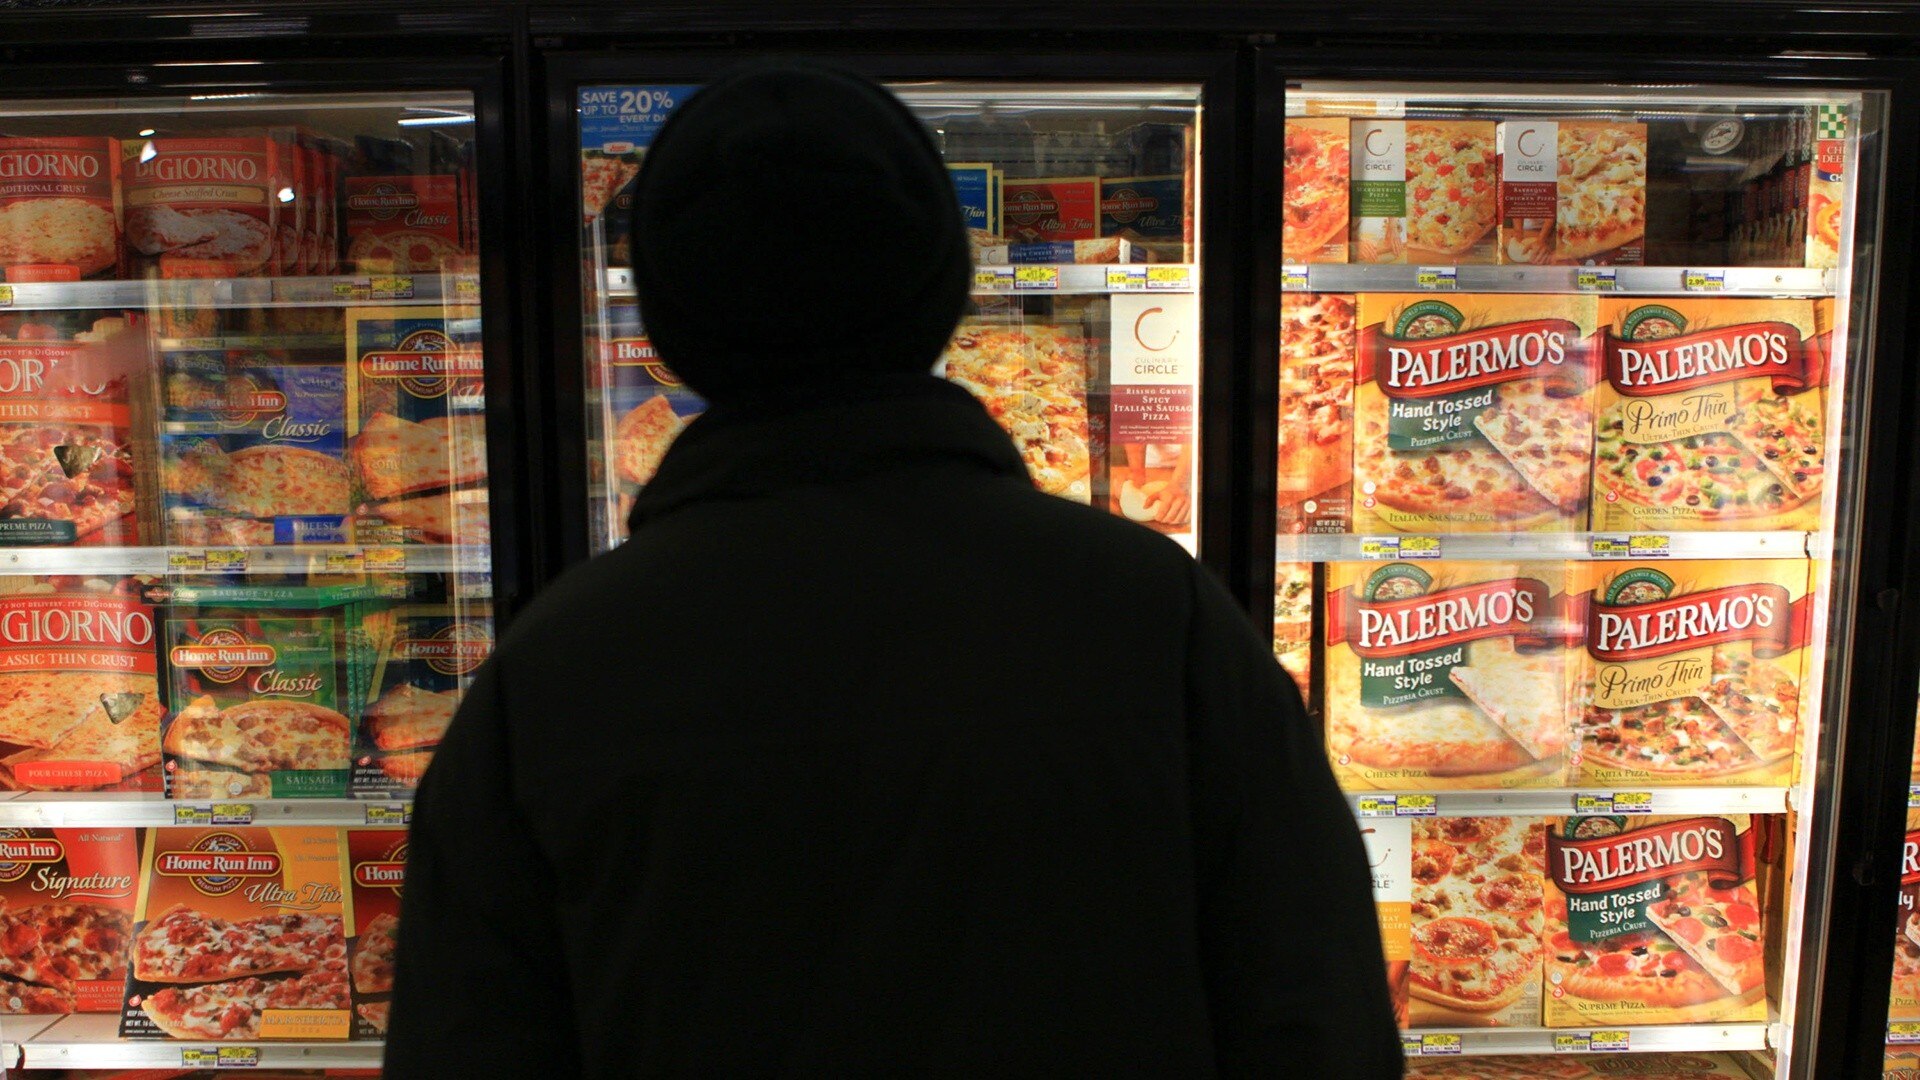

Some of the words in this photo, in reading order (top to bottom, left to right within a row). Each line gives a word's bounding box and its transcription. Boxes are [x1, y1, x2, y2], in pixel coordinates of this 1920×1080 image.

[582, 91, 618, 104] SAVE
[620, 90, 674, 114] 20%
[582, 105, 599, 116] UP
[600, 104, 618, 115] TO
[619, 114, 651, 123] EVERY
[653, 114, 668, 123] DA
[1365, 163, 1392, 171] CIRCLE
[1517, 164, 1544, 172] CIRCLE
[55, 184, 88, 194] CRUST
[353, 197, 379, 207] Home
[1003, 203, 1022, 212] ome
[1022, 202, 1040, 212] Run
[1040, 202, 1056, 211] Inn
[404, 209, 449, 227] Classic
[960, 204, 986, 219] Thin
[1037, 217, 1067, 231] Ultra
[1070, 217, 1094, 231] Thin
[1137, 215, 1166, 228] Ultra
[977, 276, 995, 284] 3.59
[1109, 275, 1127, 283] 3.59
[1579, 276, 1596, 284] 2.99
[1688, 278, 1706, 286] 2.99
[371, 356, 420, 371] Home
[421, 355, 455, 373] Run
[1387, 329, 1566, 388] PALERMO'S
[1617, 330, 1789, 387] PALERMO'S
[1134, 364, 1179, 375] CIRCLE
[1159, 387, 1188, 395] CRUST
[254, 396, 280, 407] Inn
[1142, 395, 1171, 404] SPICY
[1392, 402, 1434, 418] Hand
[1438, 390, 1493, 415] Tossed
[1, 403, 39, 417] THIN
[1113, 404, 1148, 413] ITALIAN
[1625, 398, 1690, 435] Primo
[1682, 392, 1729, 424] Thin
[1142, 412, 1171, 421] PIZZA
[1422, 414, 1463, 433] Style
[262, 414, 332, 440] Classic
[1410, 434, 1446, 447] PIZZERIA
[1446, 429, 1474, 441] CRUST
[1388, 512, 1427, 523] ITALIAN
[1632, 506, 1670, 516] GARDEN
[1671, 506, 1697, 516] PIZZA
[28, 522, 53, 531] PIZZA
[1357, 588, 1535, 649] PALERMO'S
[1596, 593, 1775, 652] PALERMO'S
[0, 608, 153, 646] GIORNO
[404, 642, 452, 656] Home
[49, 653, 88, 665] THIN
[91, 653, 138, 667] CRUST
[178, 649, 218, 662] Home
[218, 649, 246, 664] Run
[246, 649, 270, 661] Inn
[1363, 662, 1406, 678] Hand
[1409, 647, 1463, 675] Tossed
[253, 668, 324, 694] Classic
[1393, 672, 1434, 692] Style
[1600, 664, 1664, 700] Primo
[1657, 656, 1705, 687] Thin
[1382, 692, 1417, 706] PIZZERIA
[1417, 686, 1445, 699] CRUST
[1665, 687, 1692, 698] CRUST
[28, 769, 51, 778] FOUR
[51, 769, 83, 778] CHEESE
[85, 769, 109, 778] PIZZA
[285, 775, 337, 786] SAUSAGE
[1364, 768, 1399, 779] CHEESE
[1401, 768, 1429, 778] PIZZA
[1594, 768, 1622, 780] FAJITA
[1624, 768, 1651, 778] PIZZA
[1578, 799, 1595, 807] 7.59
[368, 810, 386, 818] 6.99
[78, 834, 90, 843] All
[0, 842, 28, 859] Run
[29, 842, 56, 857] Inn
[1560, 826, 1724, 885] PALERMO'S
[165, 855, 213, 871] Home
[213, 855, 246, 873] Run
[246, 856, 274, 871] Inn
[364, 866, 405, 881] Hom
[31, 866, 133, 899] Signature
[196, 877, 223, 893] PREMIUM
[222, 877, 239, 892] PIZZA
[244, 881, 298, 903] Ultra
[1569, 897, 1609, 913] Hand
[1611, 883, 1662, 908] Tossed
[1599, 907, 1636, 925] Style
[1589, 926, 1622, 939] PIZZERIA
[1622, 921, 1647, 932] CRUST
[77, 985, 99, 993] MEAT
[1578, 1002, 1618, 1012] SUPREME
[1619, 1000, 1646, 1010] PIZZA
[184, 1052, 201, 1060] 6.99
